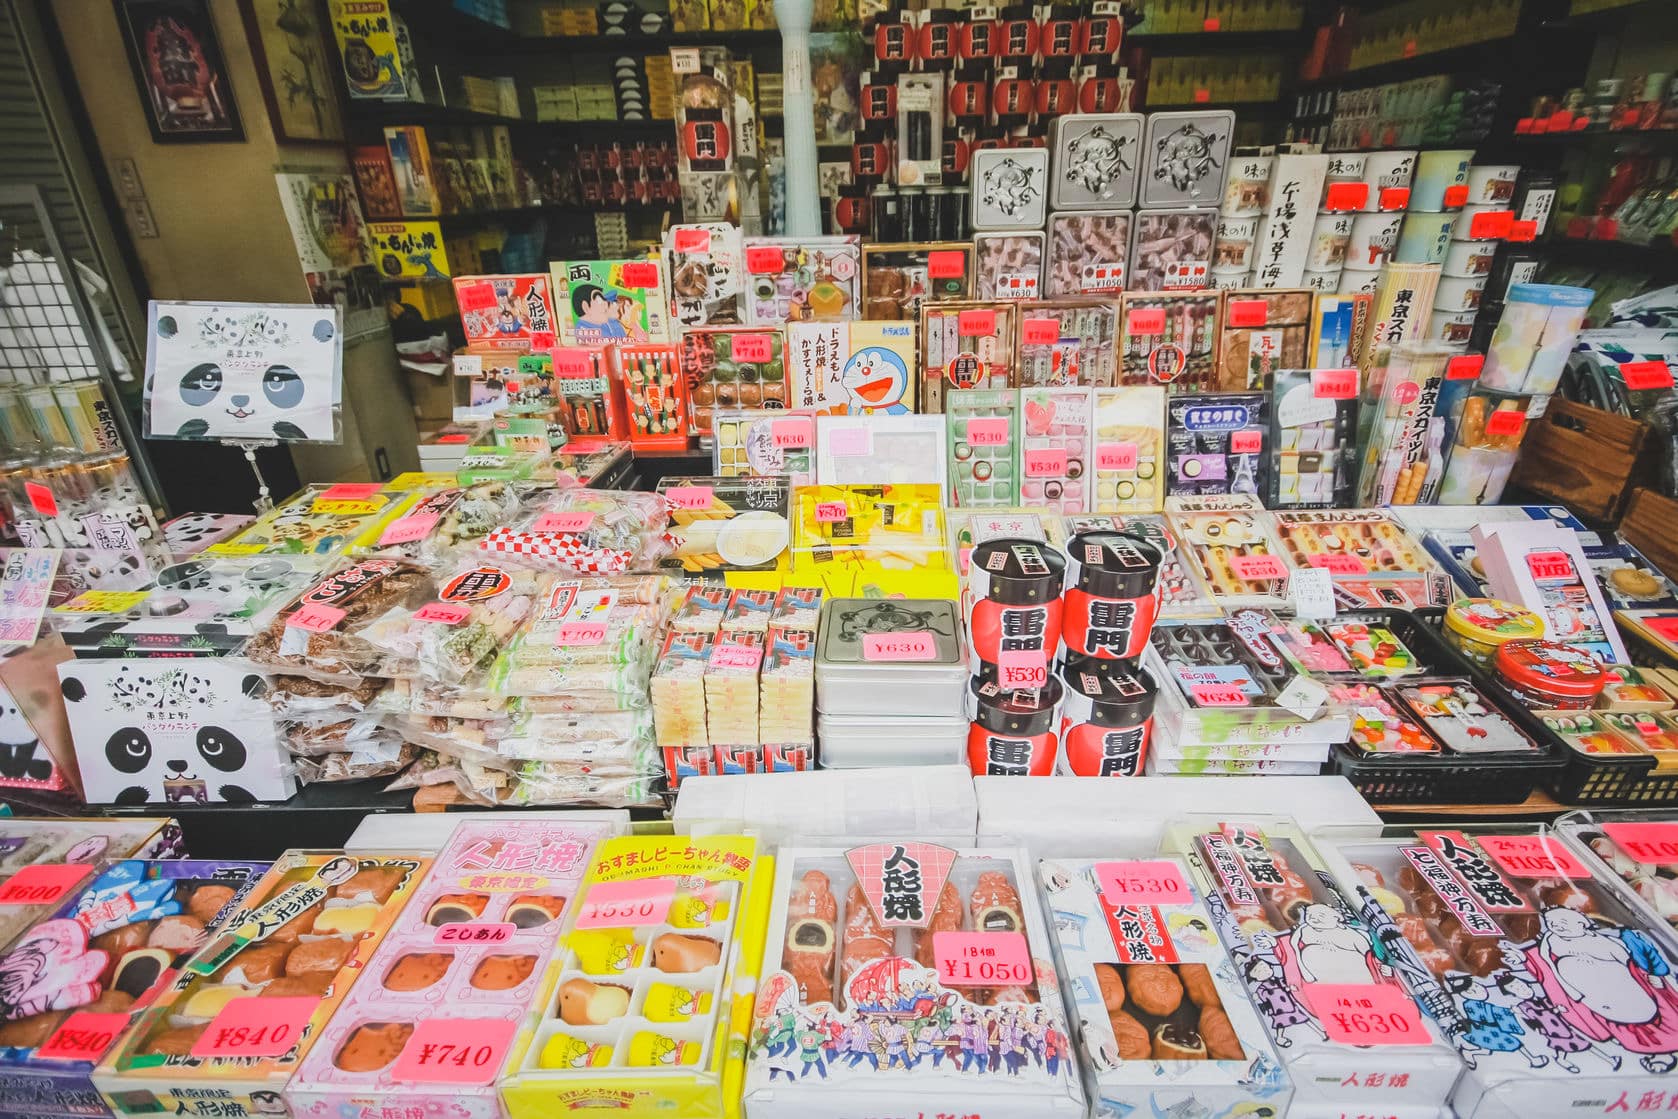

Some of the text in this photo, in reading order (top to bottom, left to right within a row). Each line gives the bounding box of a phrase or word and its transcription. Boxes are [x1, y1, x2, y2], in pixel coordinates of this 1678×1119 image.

[1096, 279, 1122, 288] ¥1050
[525, 286, 553, 331] 人形焼
[815, 334, 827, 367] 人形焼
[829, 328, 840, 383] ドラえもん
[775, 433, 805, 445] ¥630
[972, 432, 1003, 443] ¥530
[1031, 461, 1061, 473] ¥530
[1101, 454, 1131, 465] ¥530
[1086, 600, 1138, 657] 雷門
[874, 641, 926, 655] ¥630
[1006, 666, 1047, 683] ¥530
[454, 841, 586, 872] 人形焼
[4, 885, 63, 899] ¥600
[883, 846, 923, 921] 人形焼
[1114, 878, 1180, 894] ¥530
[256, 887, 325, 938] 人形焼
[1115, 905, 1155, 961] 人形焼
[943, 959, 1028, 982] ¥1050
[1330, 1013, 1411, 1034] ¥630
[212, 1023, 291, 1049] ¥840
[417, 1043, 494, 1067] ¥740
[1340, 1072, 1411, 1089] 人形焼
[174, 1101, 250, 1118] 人形焼
